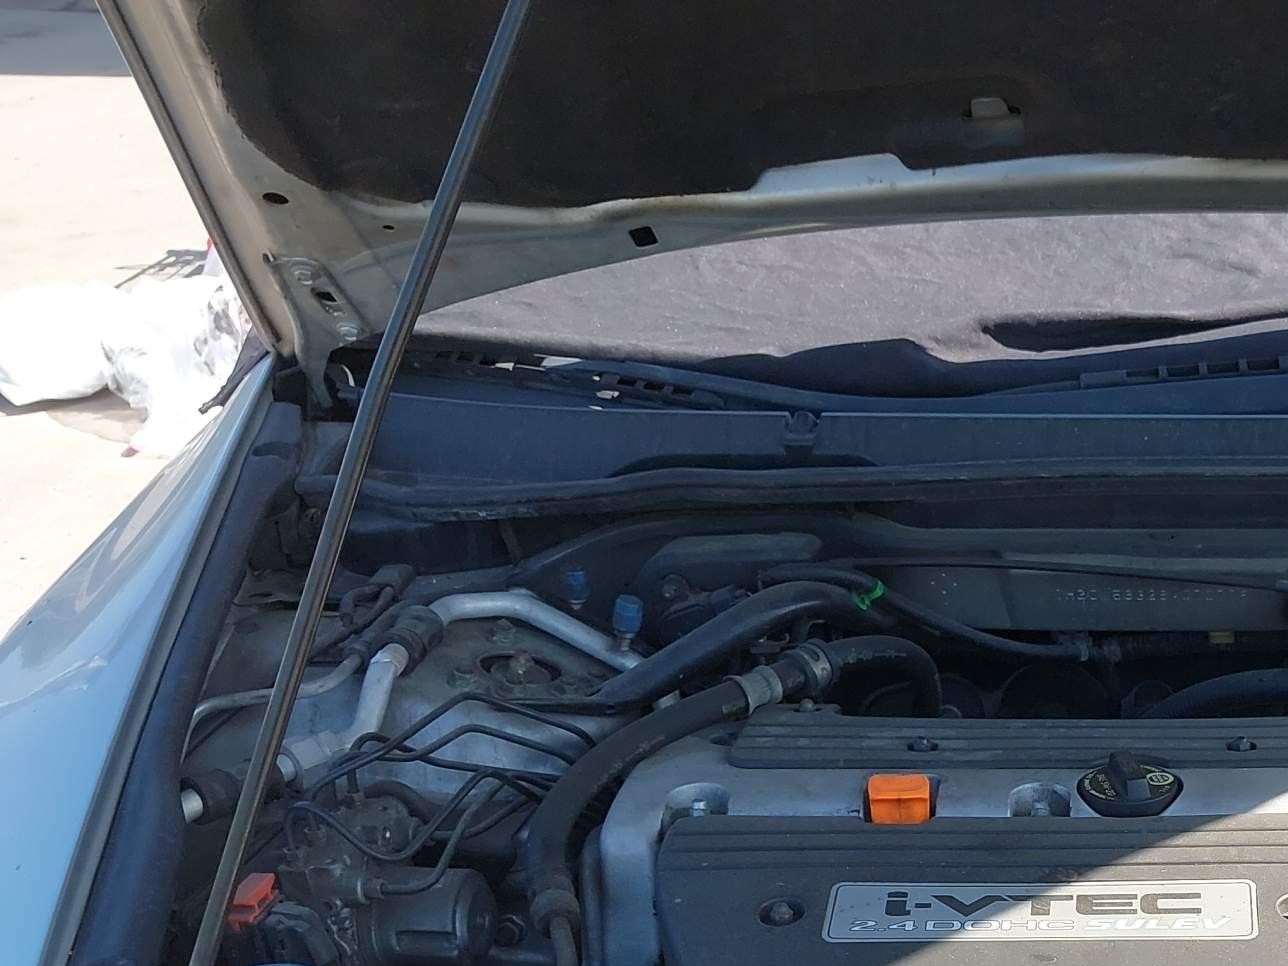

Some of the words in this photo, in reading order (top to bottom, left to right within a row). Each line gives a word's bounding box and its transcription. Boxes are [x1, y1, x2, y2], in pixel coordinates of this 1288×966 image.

[884, 890, 1203, 918] i-VTEC
[848, 919, 920, 932] 2.4
[923, 919, 1075, 931] DOHC
[1084, 917, 1232, 931] SULEV
